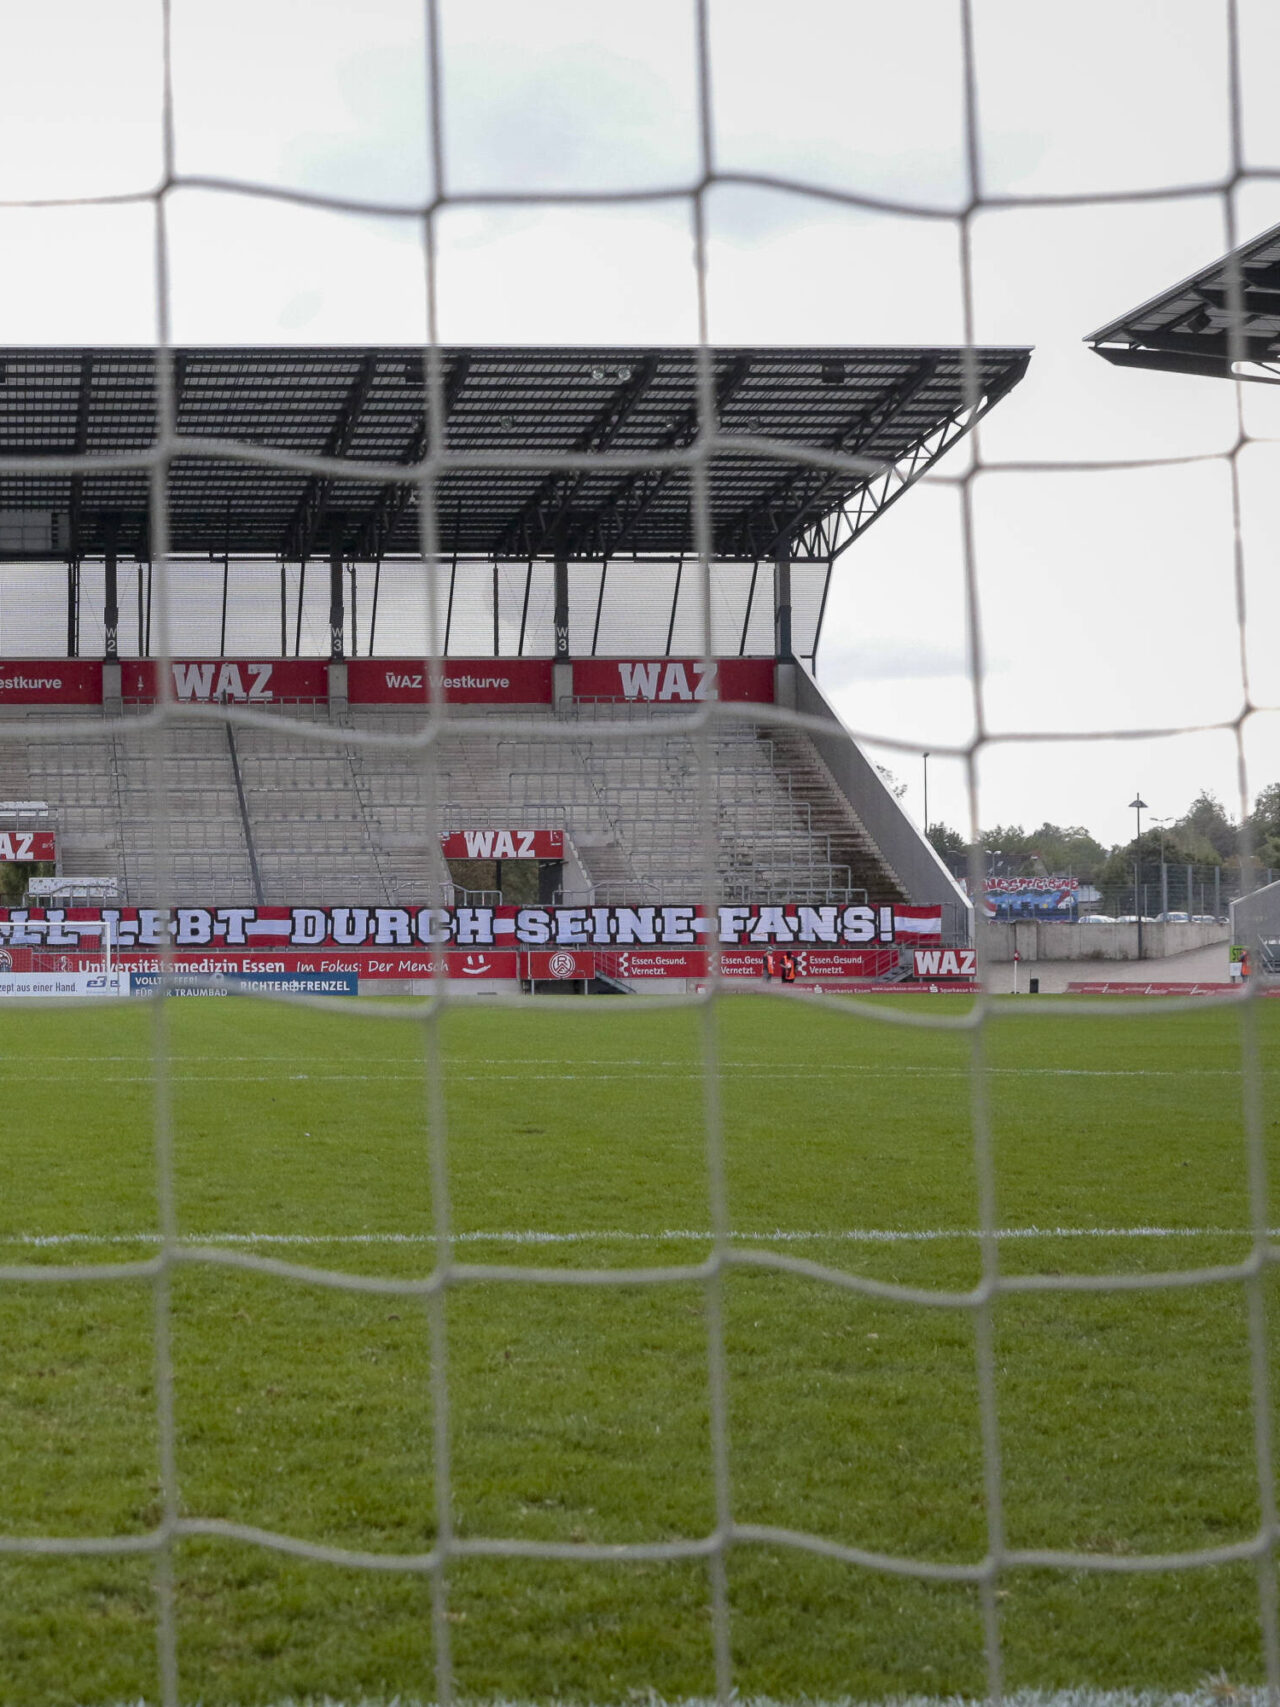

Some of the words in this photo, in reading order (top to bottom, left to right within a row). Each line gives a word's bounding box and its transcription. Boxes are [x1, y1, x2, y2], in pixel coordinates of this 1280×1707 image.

[172, 663, 273, 701] WAZ
[618, 663, 718, 700] WAZ
[463, 831, 535, 858] WAZ
[100, 906, 257, 946] LEBT
[290, 906, 495, 946] DURCH
[515, 905, 698, 945] SEINE
[717, 904, 895, 945] FANS!
[242, 959, 285, 973] Essen
[296, 961, 315, 972] Im
[321, 959, 362, 973] Fokus:
[368, 960, 394, 972] Der
[721, 956, 776, 965] Essen.Gesu.
[914, 950, 976, 975] WAZ
[631, 967, 667, 975] Vernetzt.
[721, 966, 756, 975] Vernetzt.
[809, 966, 844, 974] Vernetzt.
[16, 984, 31, 992] aus
[33, 982, 52, 992] einer
[55, 982, 78, 992] Hand.
[135, 987, 153, 997] FÜR
[175, 988, 228, 997] TRAUMBAD
